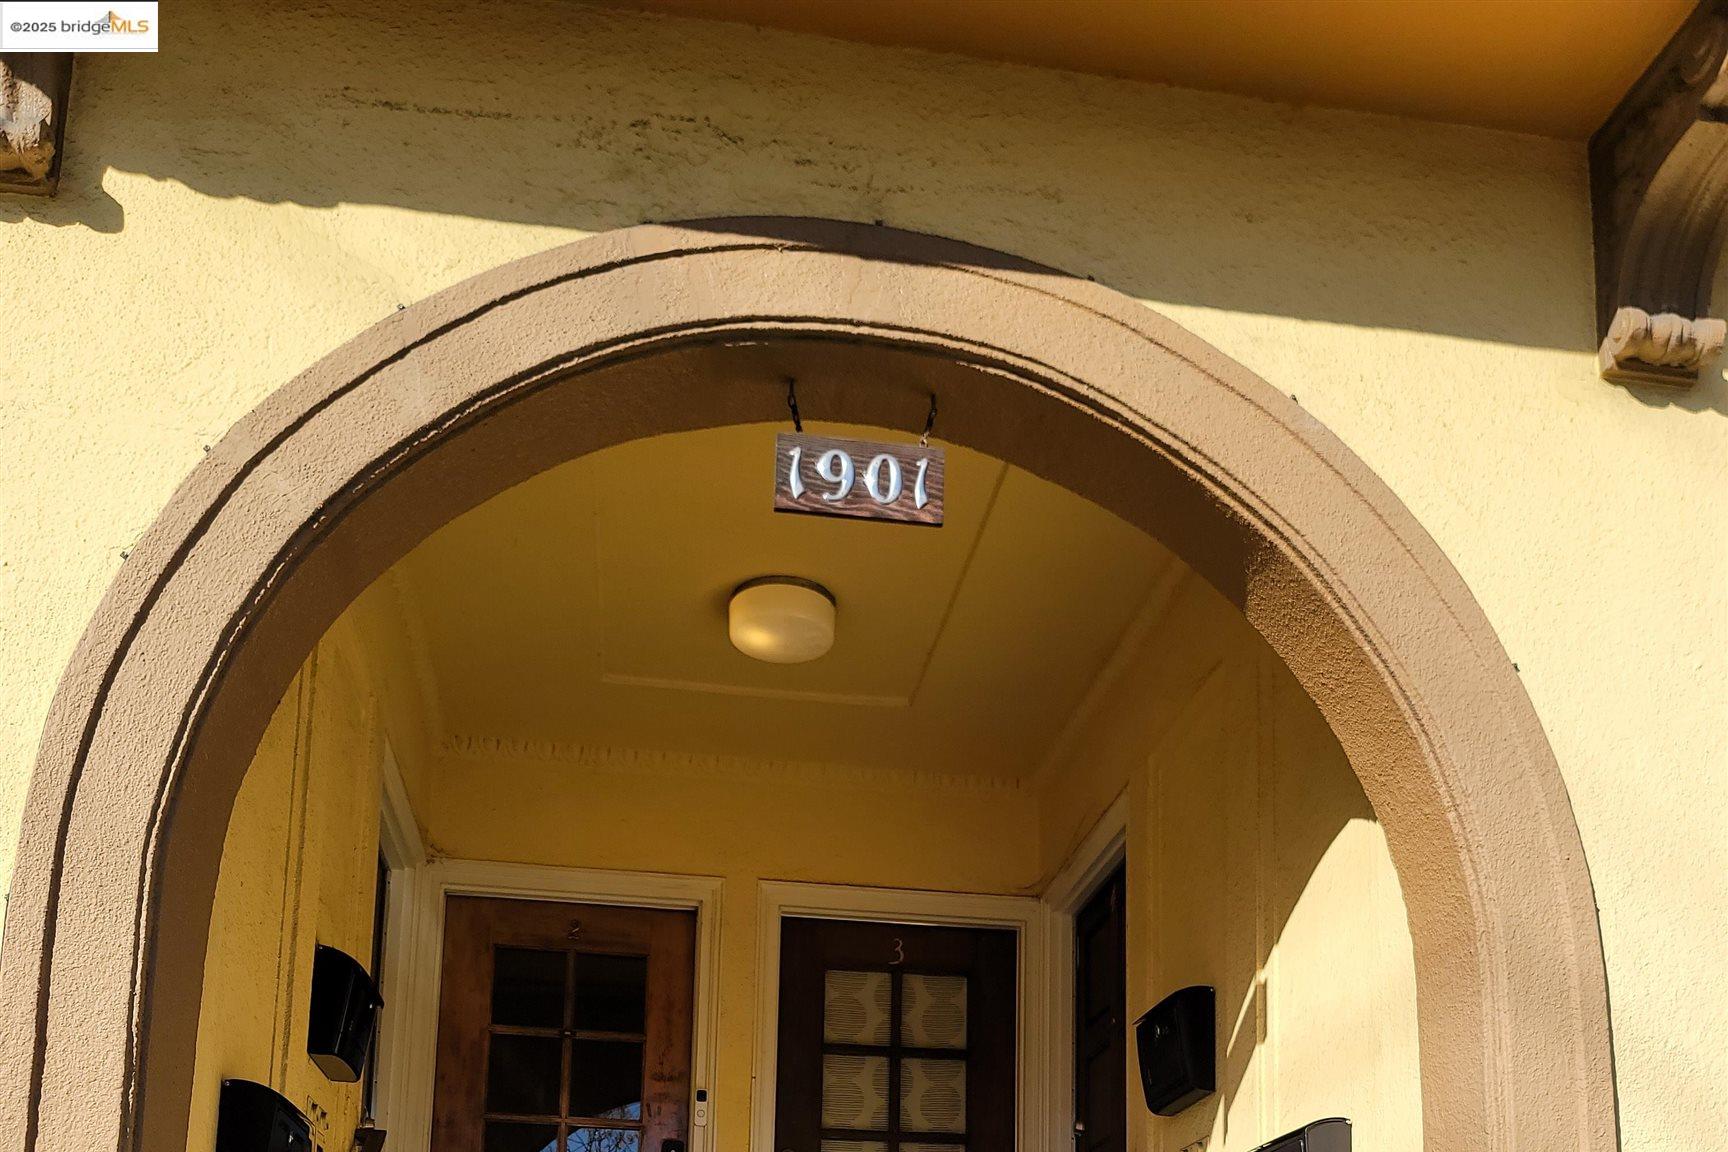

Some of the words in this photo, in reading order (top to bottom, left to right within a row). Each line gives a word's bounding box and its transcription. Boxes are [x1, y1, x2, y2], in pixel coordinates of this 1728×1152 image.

[789, 446, 929, 510] 1901
[567, 918, 582, 940] 2
[888, 938, 905, 965] 3
